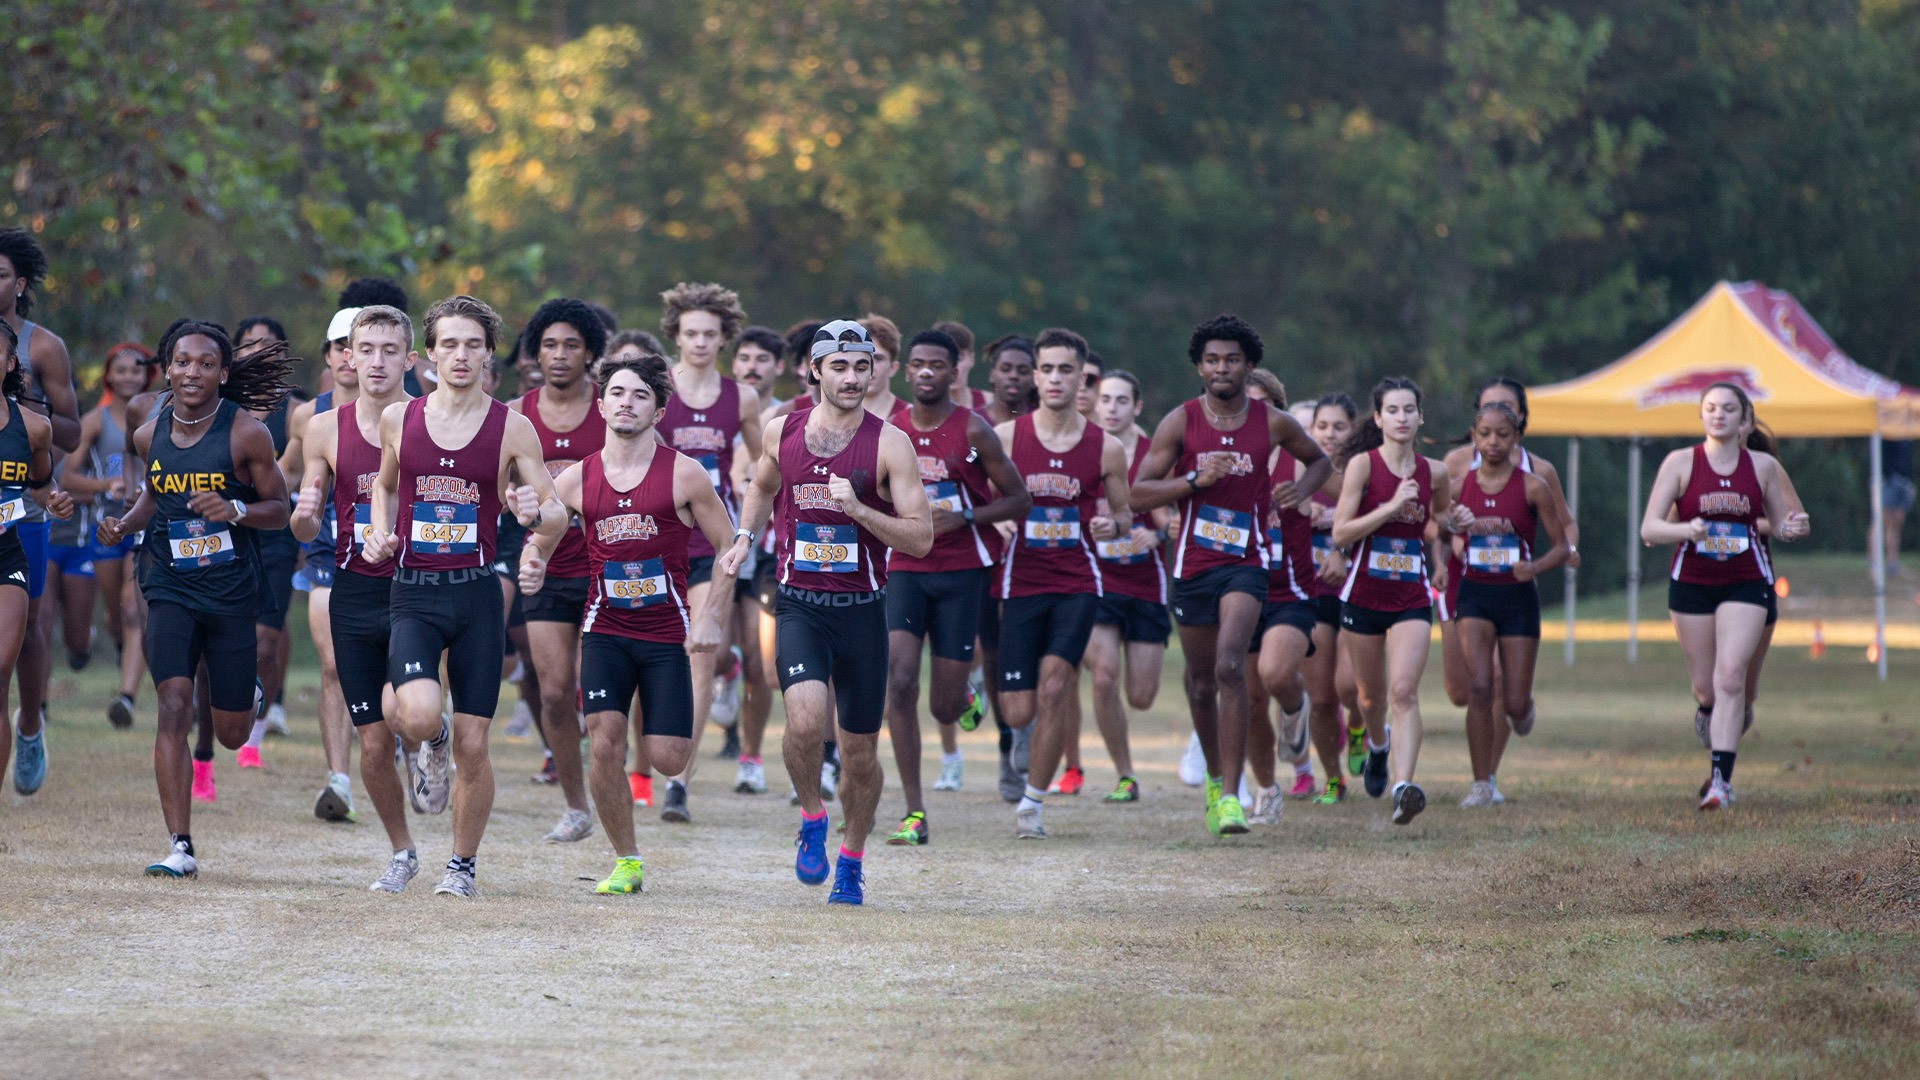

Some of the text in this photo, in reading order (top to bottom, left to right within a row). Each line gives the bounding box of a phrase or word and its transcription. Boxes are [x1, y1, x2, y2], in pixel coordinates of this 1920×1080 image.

[0, 461, 28, 481] ER
[416, 475, 480, 502] LOYOLA
[420, 524, 467, 542] 647
[596, 514, 658, 541] LOYOLA
[179, 535, 222, 557] 679
[803, 543, 848, 562] 639
[613, 579, 656, 597] 656
